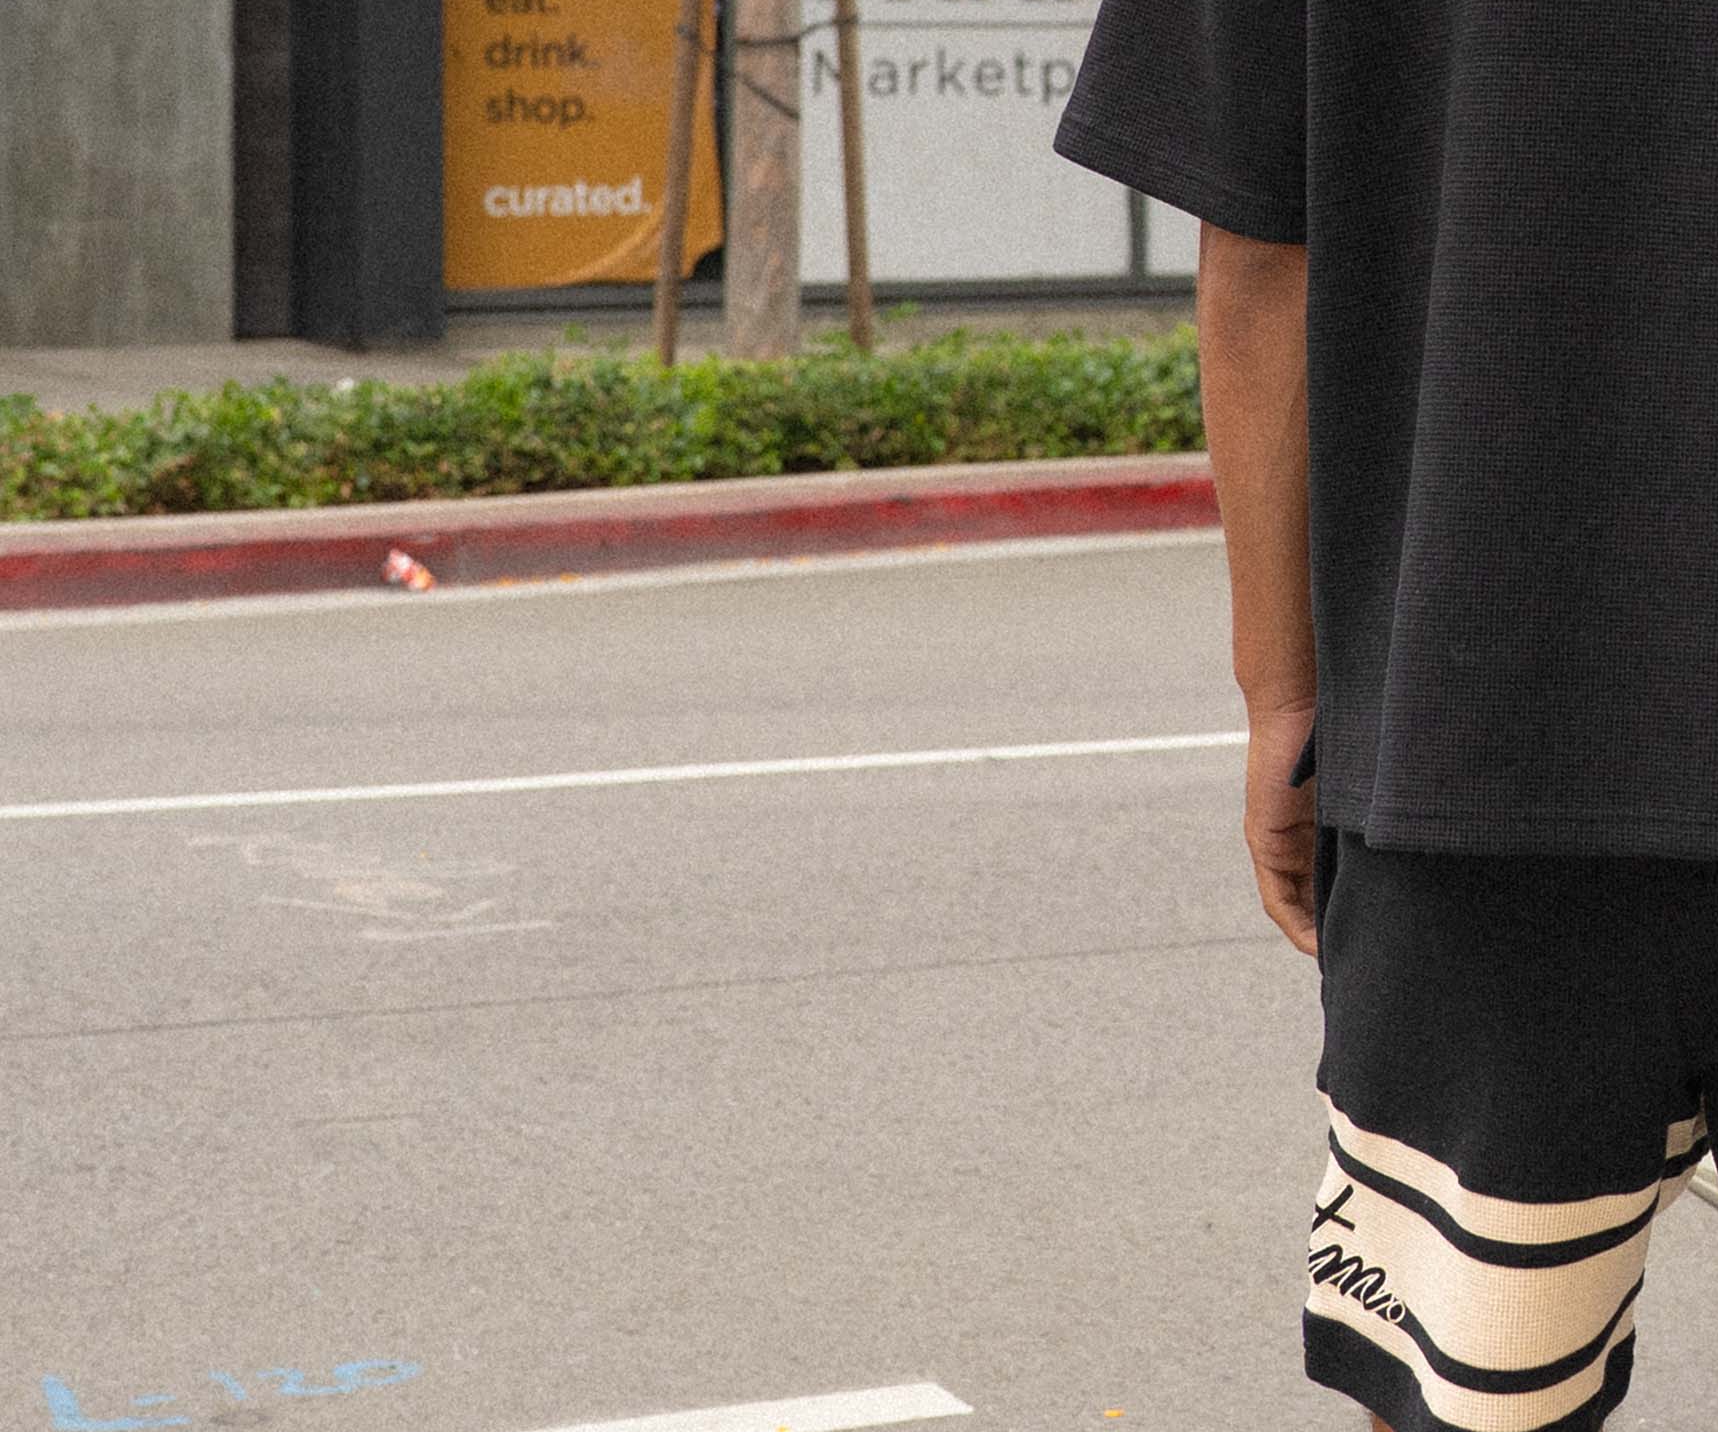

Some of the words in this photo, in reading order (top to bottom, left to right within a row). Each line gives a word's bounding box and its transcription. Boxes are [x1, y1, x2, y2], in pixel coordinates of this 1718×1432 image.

[484, 33, 600, 68] drink.
[485, 90, 595, 130] shop.
[482, 174, 653, 217] curated.
